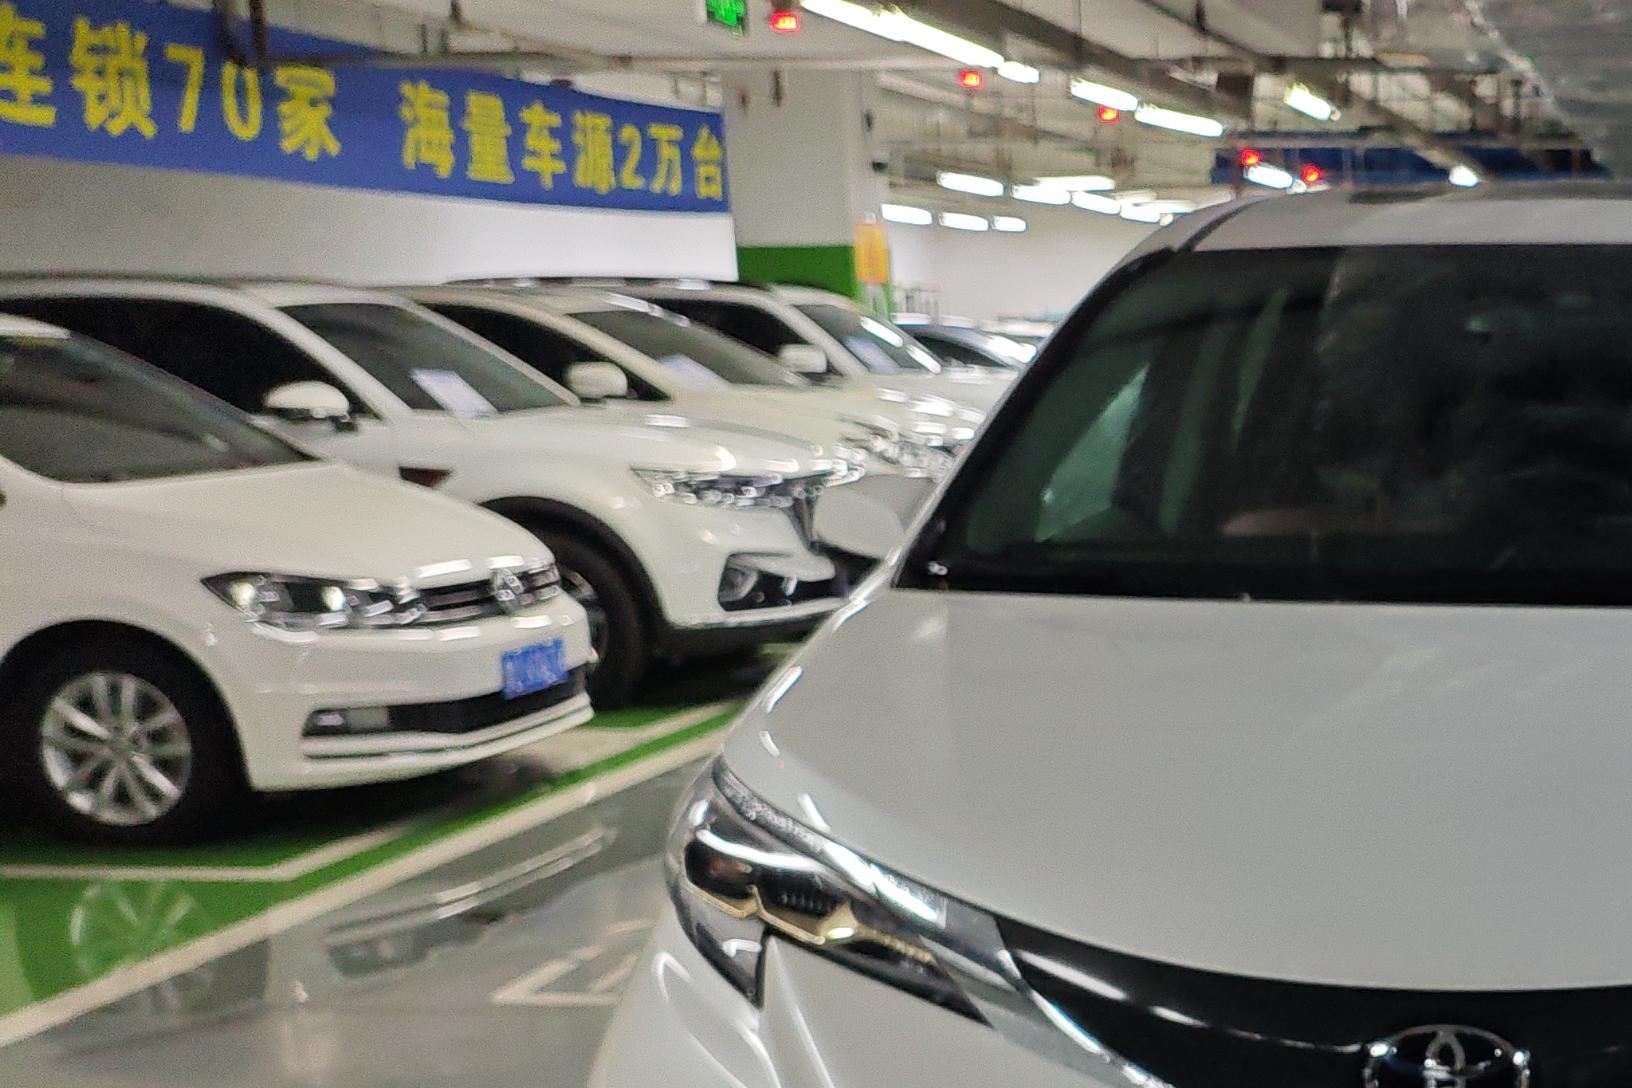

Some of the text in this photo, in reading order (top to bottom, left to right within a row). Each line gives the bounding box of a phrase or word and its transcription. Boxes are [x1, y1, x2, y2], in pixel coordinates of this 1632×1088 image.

[399, 80, 724, 200] 海量车源2万台
